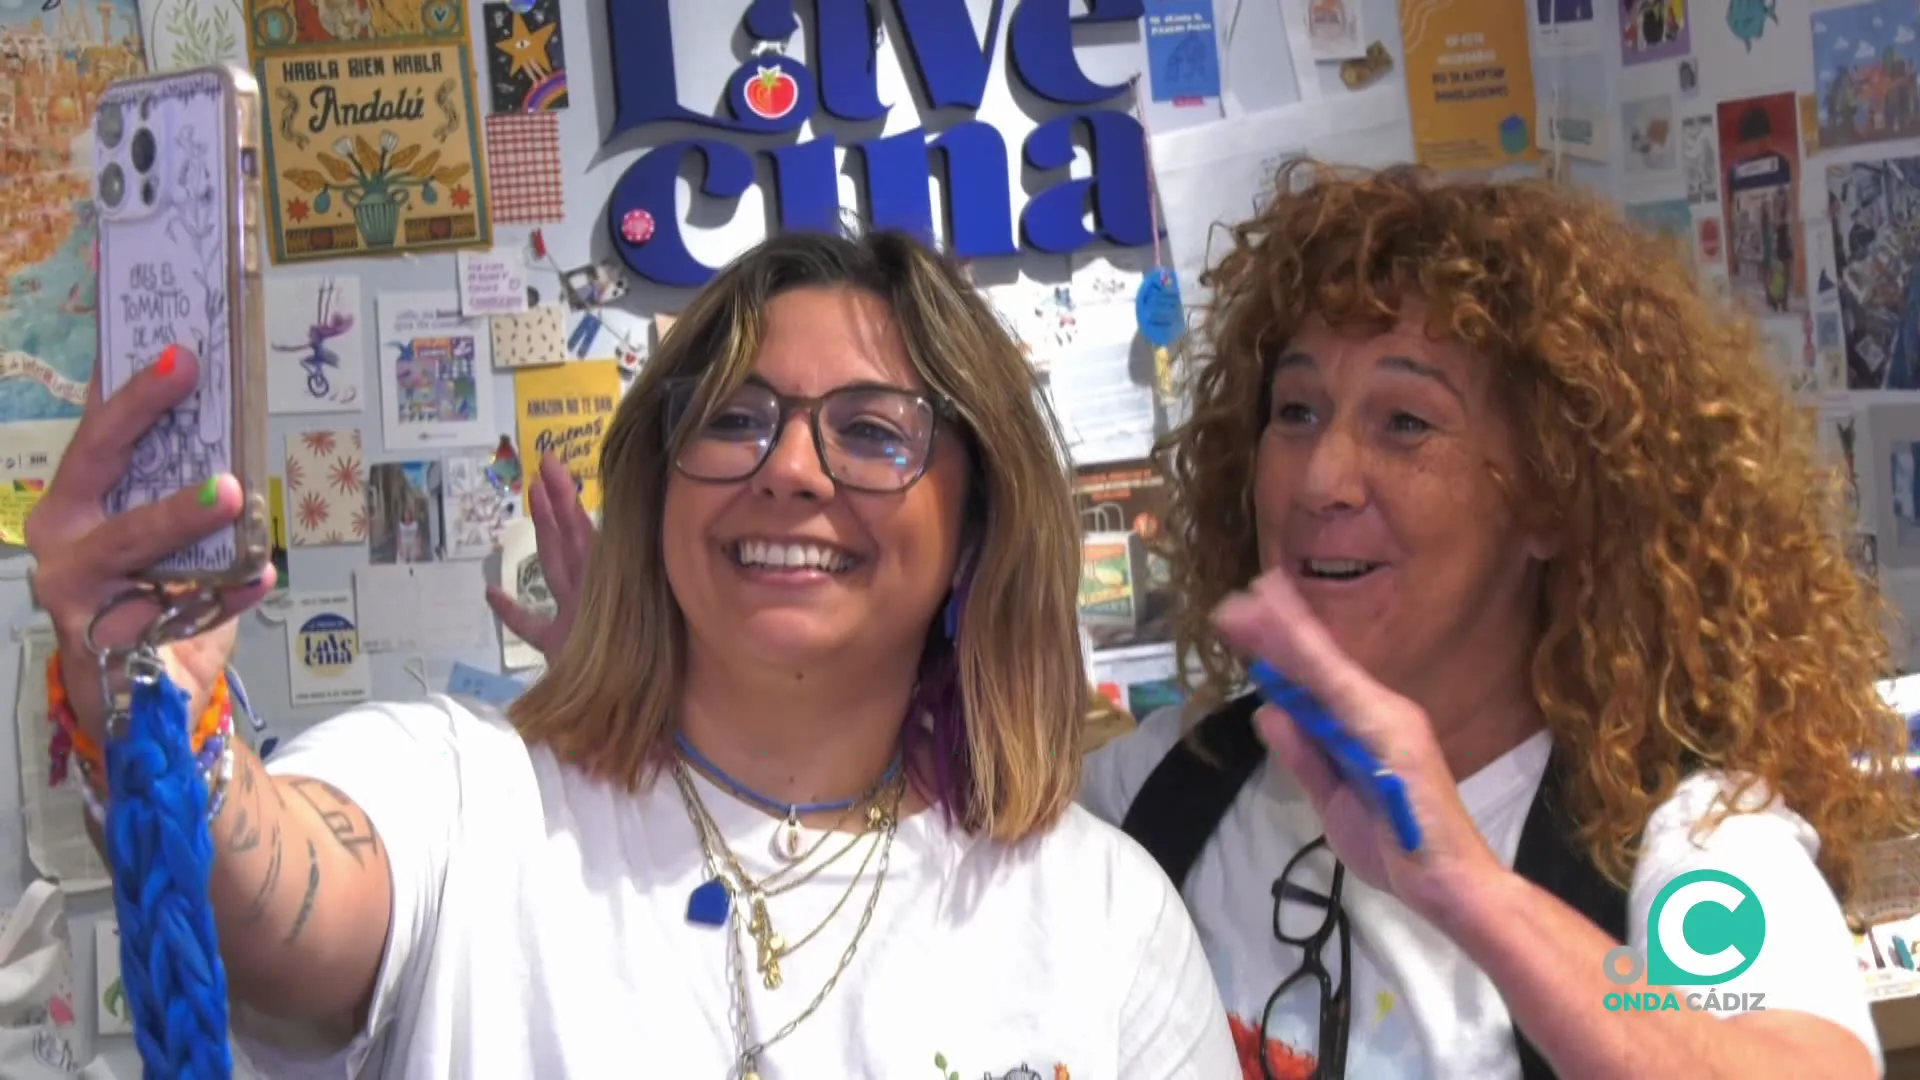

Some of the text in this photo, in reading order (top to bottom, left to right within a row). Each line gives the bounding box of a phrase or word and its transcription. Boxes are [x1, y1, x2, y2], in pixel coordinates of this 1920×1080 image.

[283, 52, 443, 82] HABLA BIEN HABLA
[527, 398, 564, 416] AMAZON
[565, 397, 578, 414] NO
[580, 397, 592, 413] TE
[535, 416, 603, 452] Buenos
